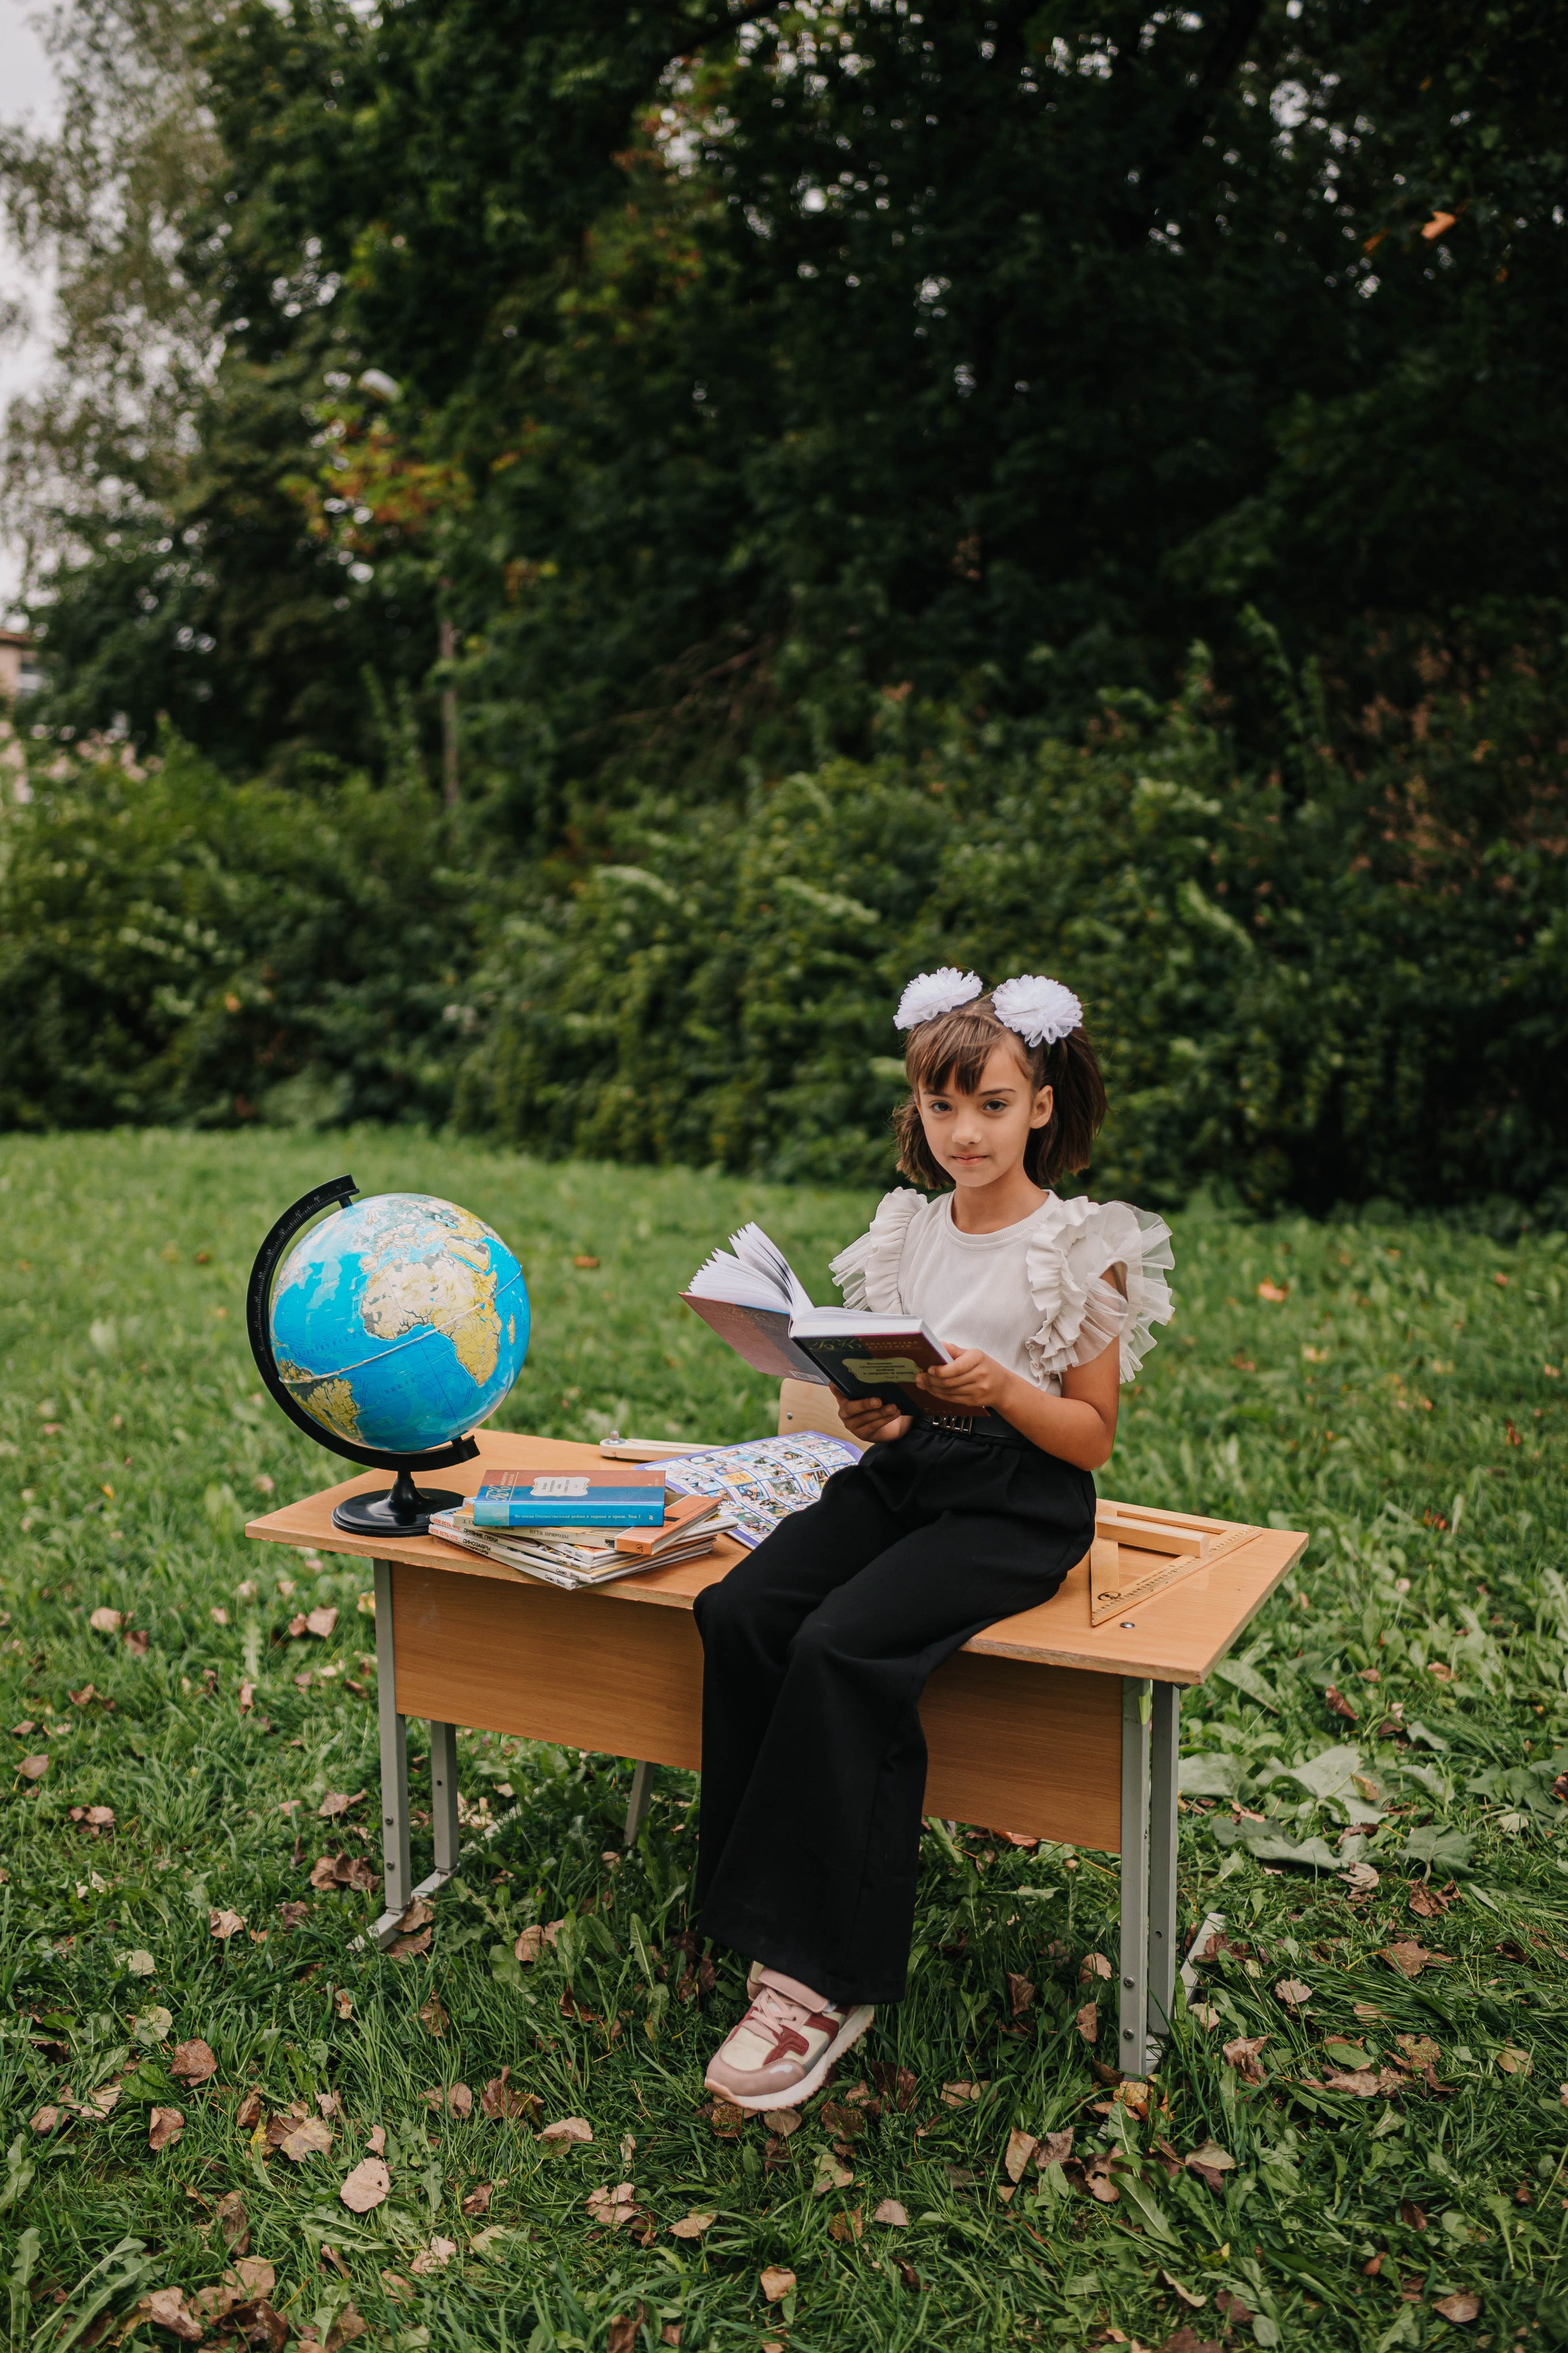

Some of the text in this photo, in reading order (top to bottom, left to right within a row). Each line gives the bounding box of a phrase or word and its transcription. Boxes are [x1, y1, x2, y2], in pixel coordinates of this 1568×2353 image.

[463, 1528, 483, 1538] ДРЕВНИЕ
[484, 1533, 499, 1543] ГРЕКИ
[545, 1531, 569, 1539] ПРИРОДЫ
[462, 1538, 491, 1551] ДИНОЗАВРЫ
